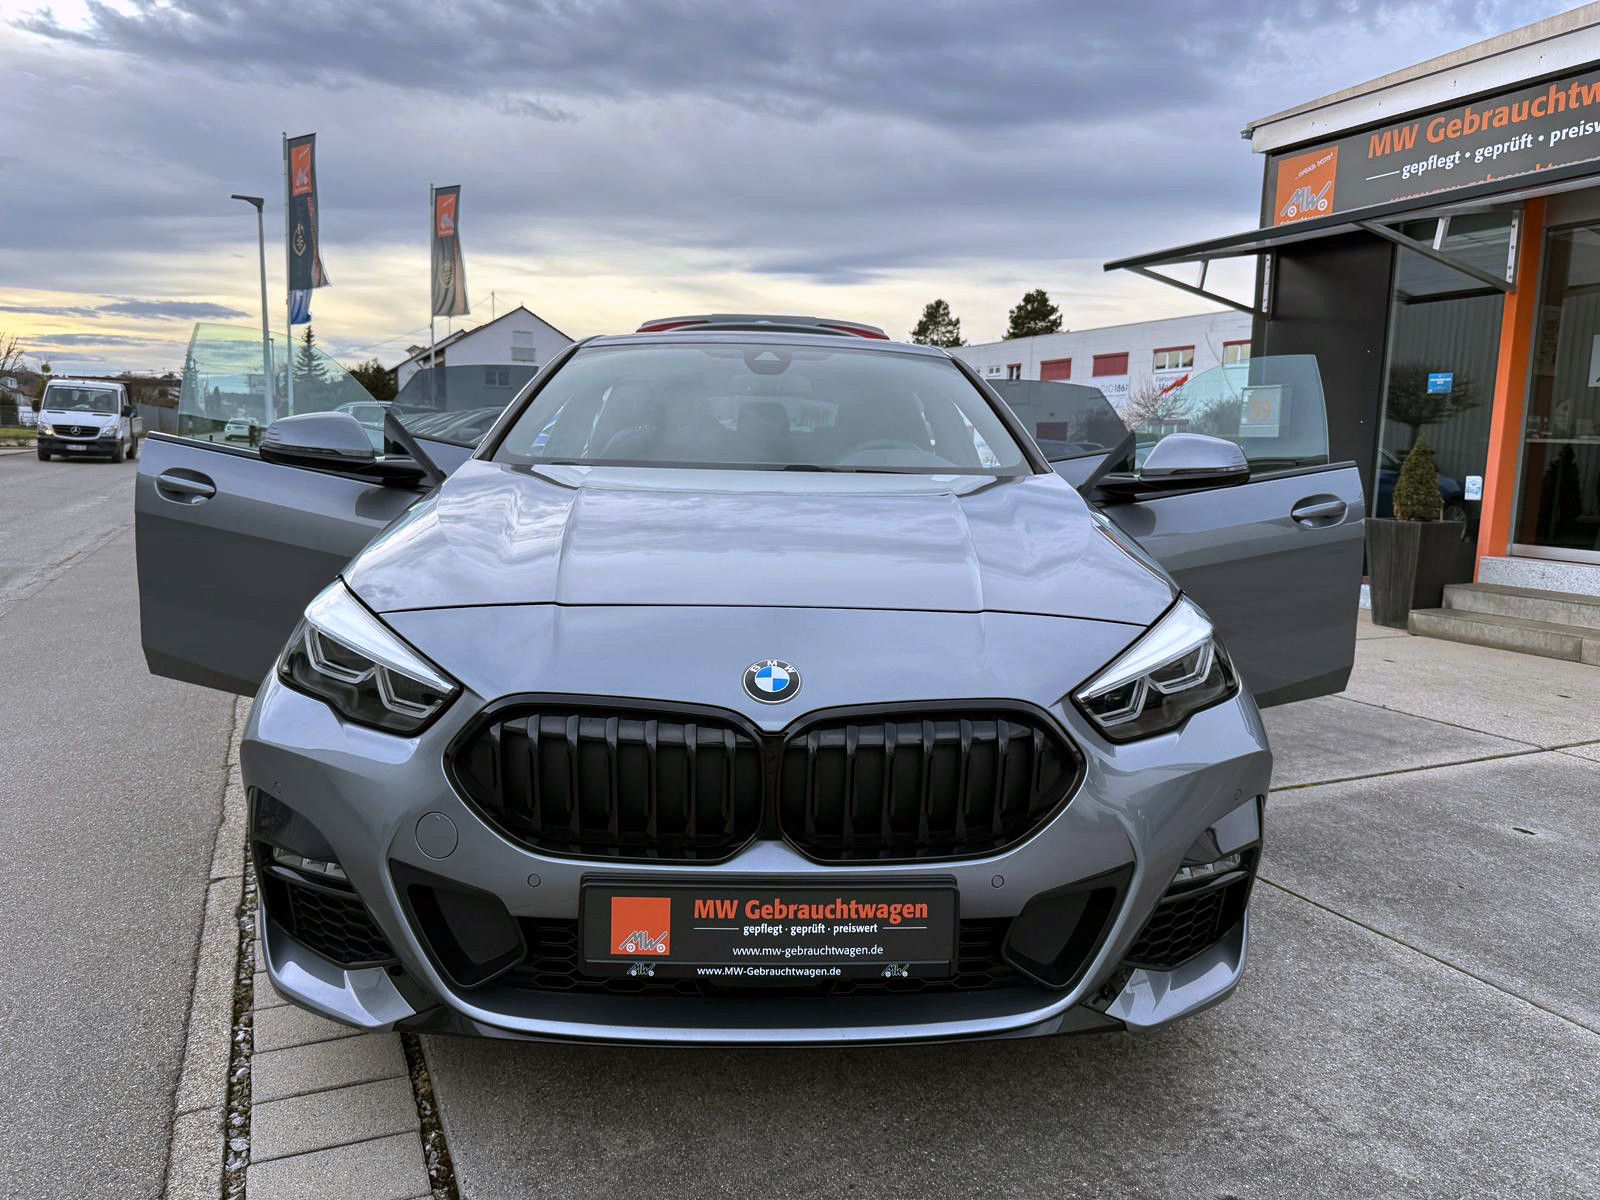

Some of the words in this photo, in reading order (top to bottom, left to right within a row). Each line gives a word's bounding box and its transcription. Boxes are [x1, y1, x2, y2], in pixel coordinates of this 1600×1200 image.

[1368, 123, 1419, 160] MW
[1402, 150, 1461, 179] gepflegt
[1474, 133, 1533, 163] geprüft
[750, 660, 795, 673] BMW
[694, 899, 739, 919] MW
[745, 898, 928, 924] Gebrauchtwagen
[743, 923, 783, 936] gepflegt
[790, 923, 826, 936] geprüft
[833, 922, 878, 935] preiswert
[732, 944, 884, 958] www.mw-gebrauchtwagen.de
[697, 966, 841, 978] www.MW-Gebrauchtwagen.de
